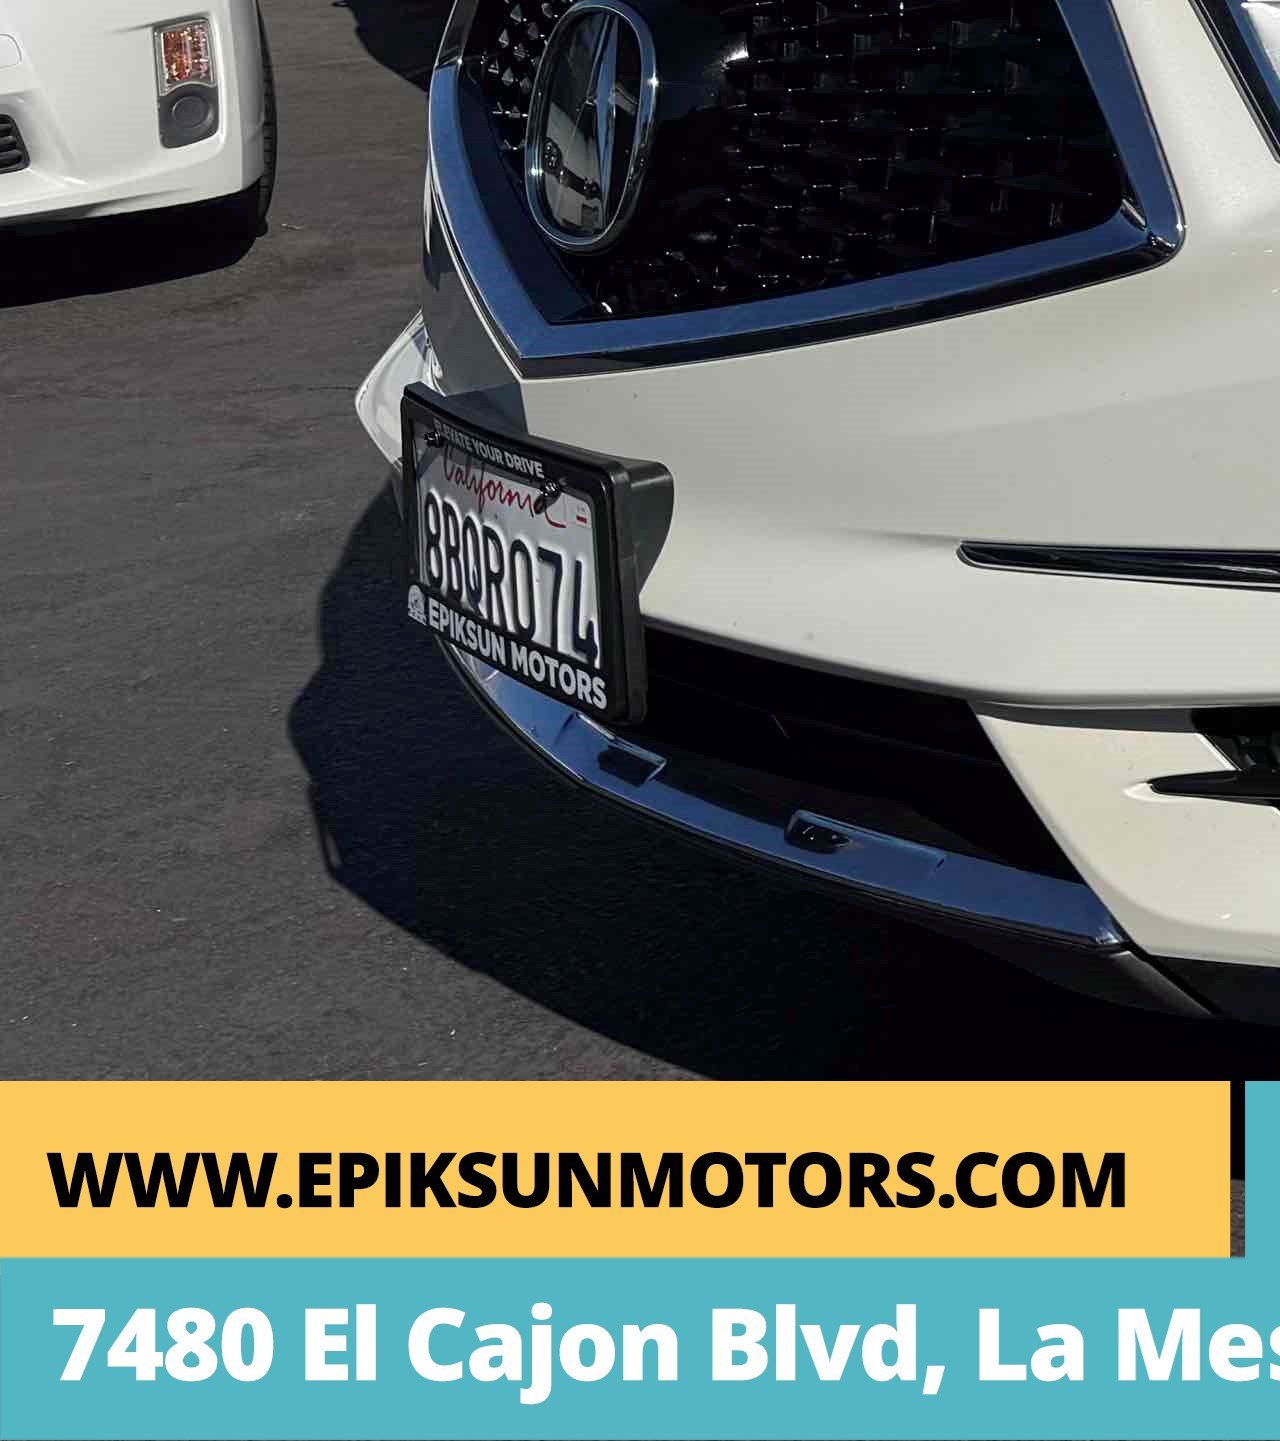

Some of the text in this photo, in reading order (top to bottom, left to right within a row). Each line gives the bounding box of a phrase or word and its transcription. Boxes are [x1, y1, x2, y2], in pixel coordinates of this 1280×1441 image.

[472, 439, 504, 466] YOUR
[505, 450, 545, 479] DRIVE
[429, 596, 608, 710] EPIKSUN MOTORS
